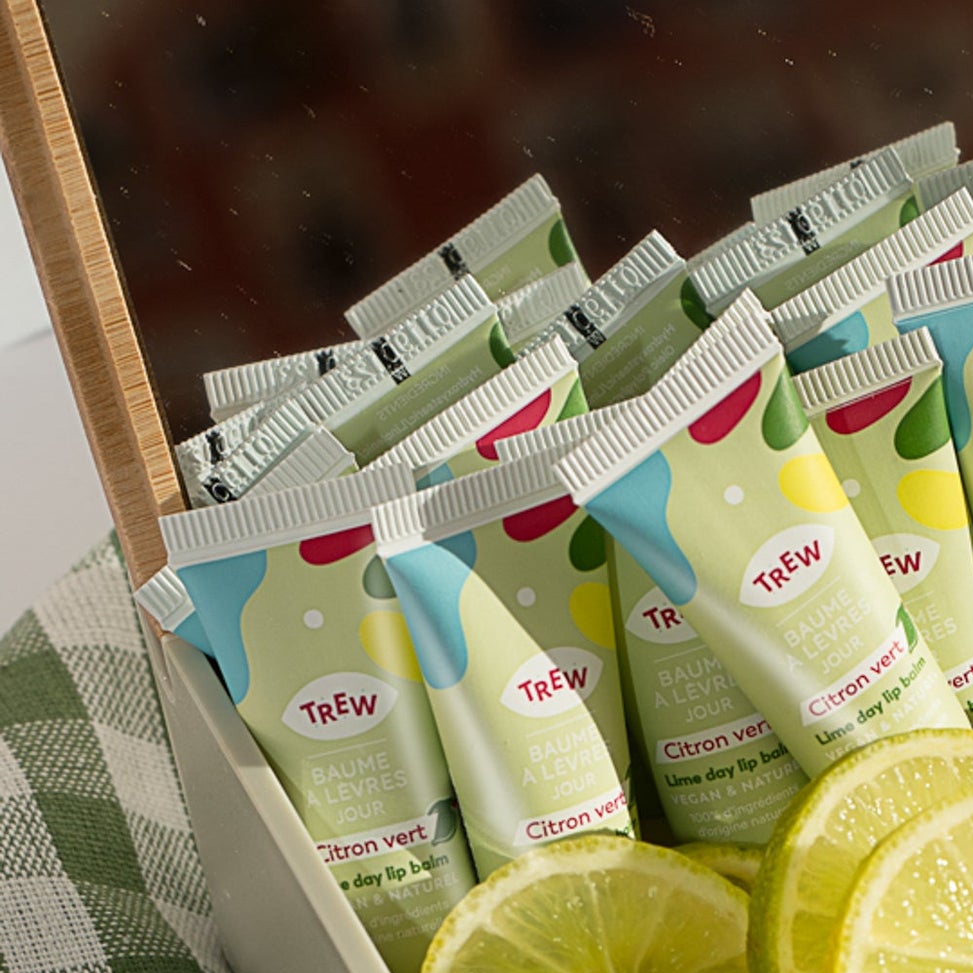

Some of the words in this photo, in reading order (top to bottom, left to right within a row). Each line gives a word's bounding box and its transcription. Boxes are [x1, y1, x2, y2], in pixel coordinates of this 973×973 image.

[752, 540, 822, 594] TREW
[880, 551, 921, 576] EW
[643, 606, 684, 630] TR
[783, 588, 852, 648] BAUME
[920, 617, 957, 643] RES
[821, 636, 864, 674] JOUR
[517, 667, 588, 702] TREW
[657, 656, 722, 687] BAUM
[808, 673, 870, 717] Citron
[869, 640, 904, 675] vert
[299, 692, 378, 725] TREW
[686, 696, 734, 723] JOUR
[814, 721, 855, 745] Lime
[857, 701, 884, 724] day
[881, 687, 902, 704] lip
[899, 656, 926, 688] balm
[528, 724, 598, 763] BAUME
[663, 735, 729, 760] Citron
[311, 751, 390, 786] BAUME
[664, 773, 702, 787] Lime
[705, 766, 734, 781] day
[736, 757, 758, 772] lip
[553, 771, 595, 801] JOUR
[670, 790, 720, 805] VEGAN
[726, 784, 737, 798] &
[337, 800, 386, 825] JOUR
[526, 811, 592, 840] Citron
[382, 824, 428, 849] vert
[353, 873, 383, 888] day
[385, 865, 407, 882] lip
[409, 855, 449, 875] balm
